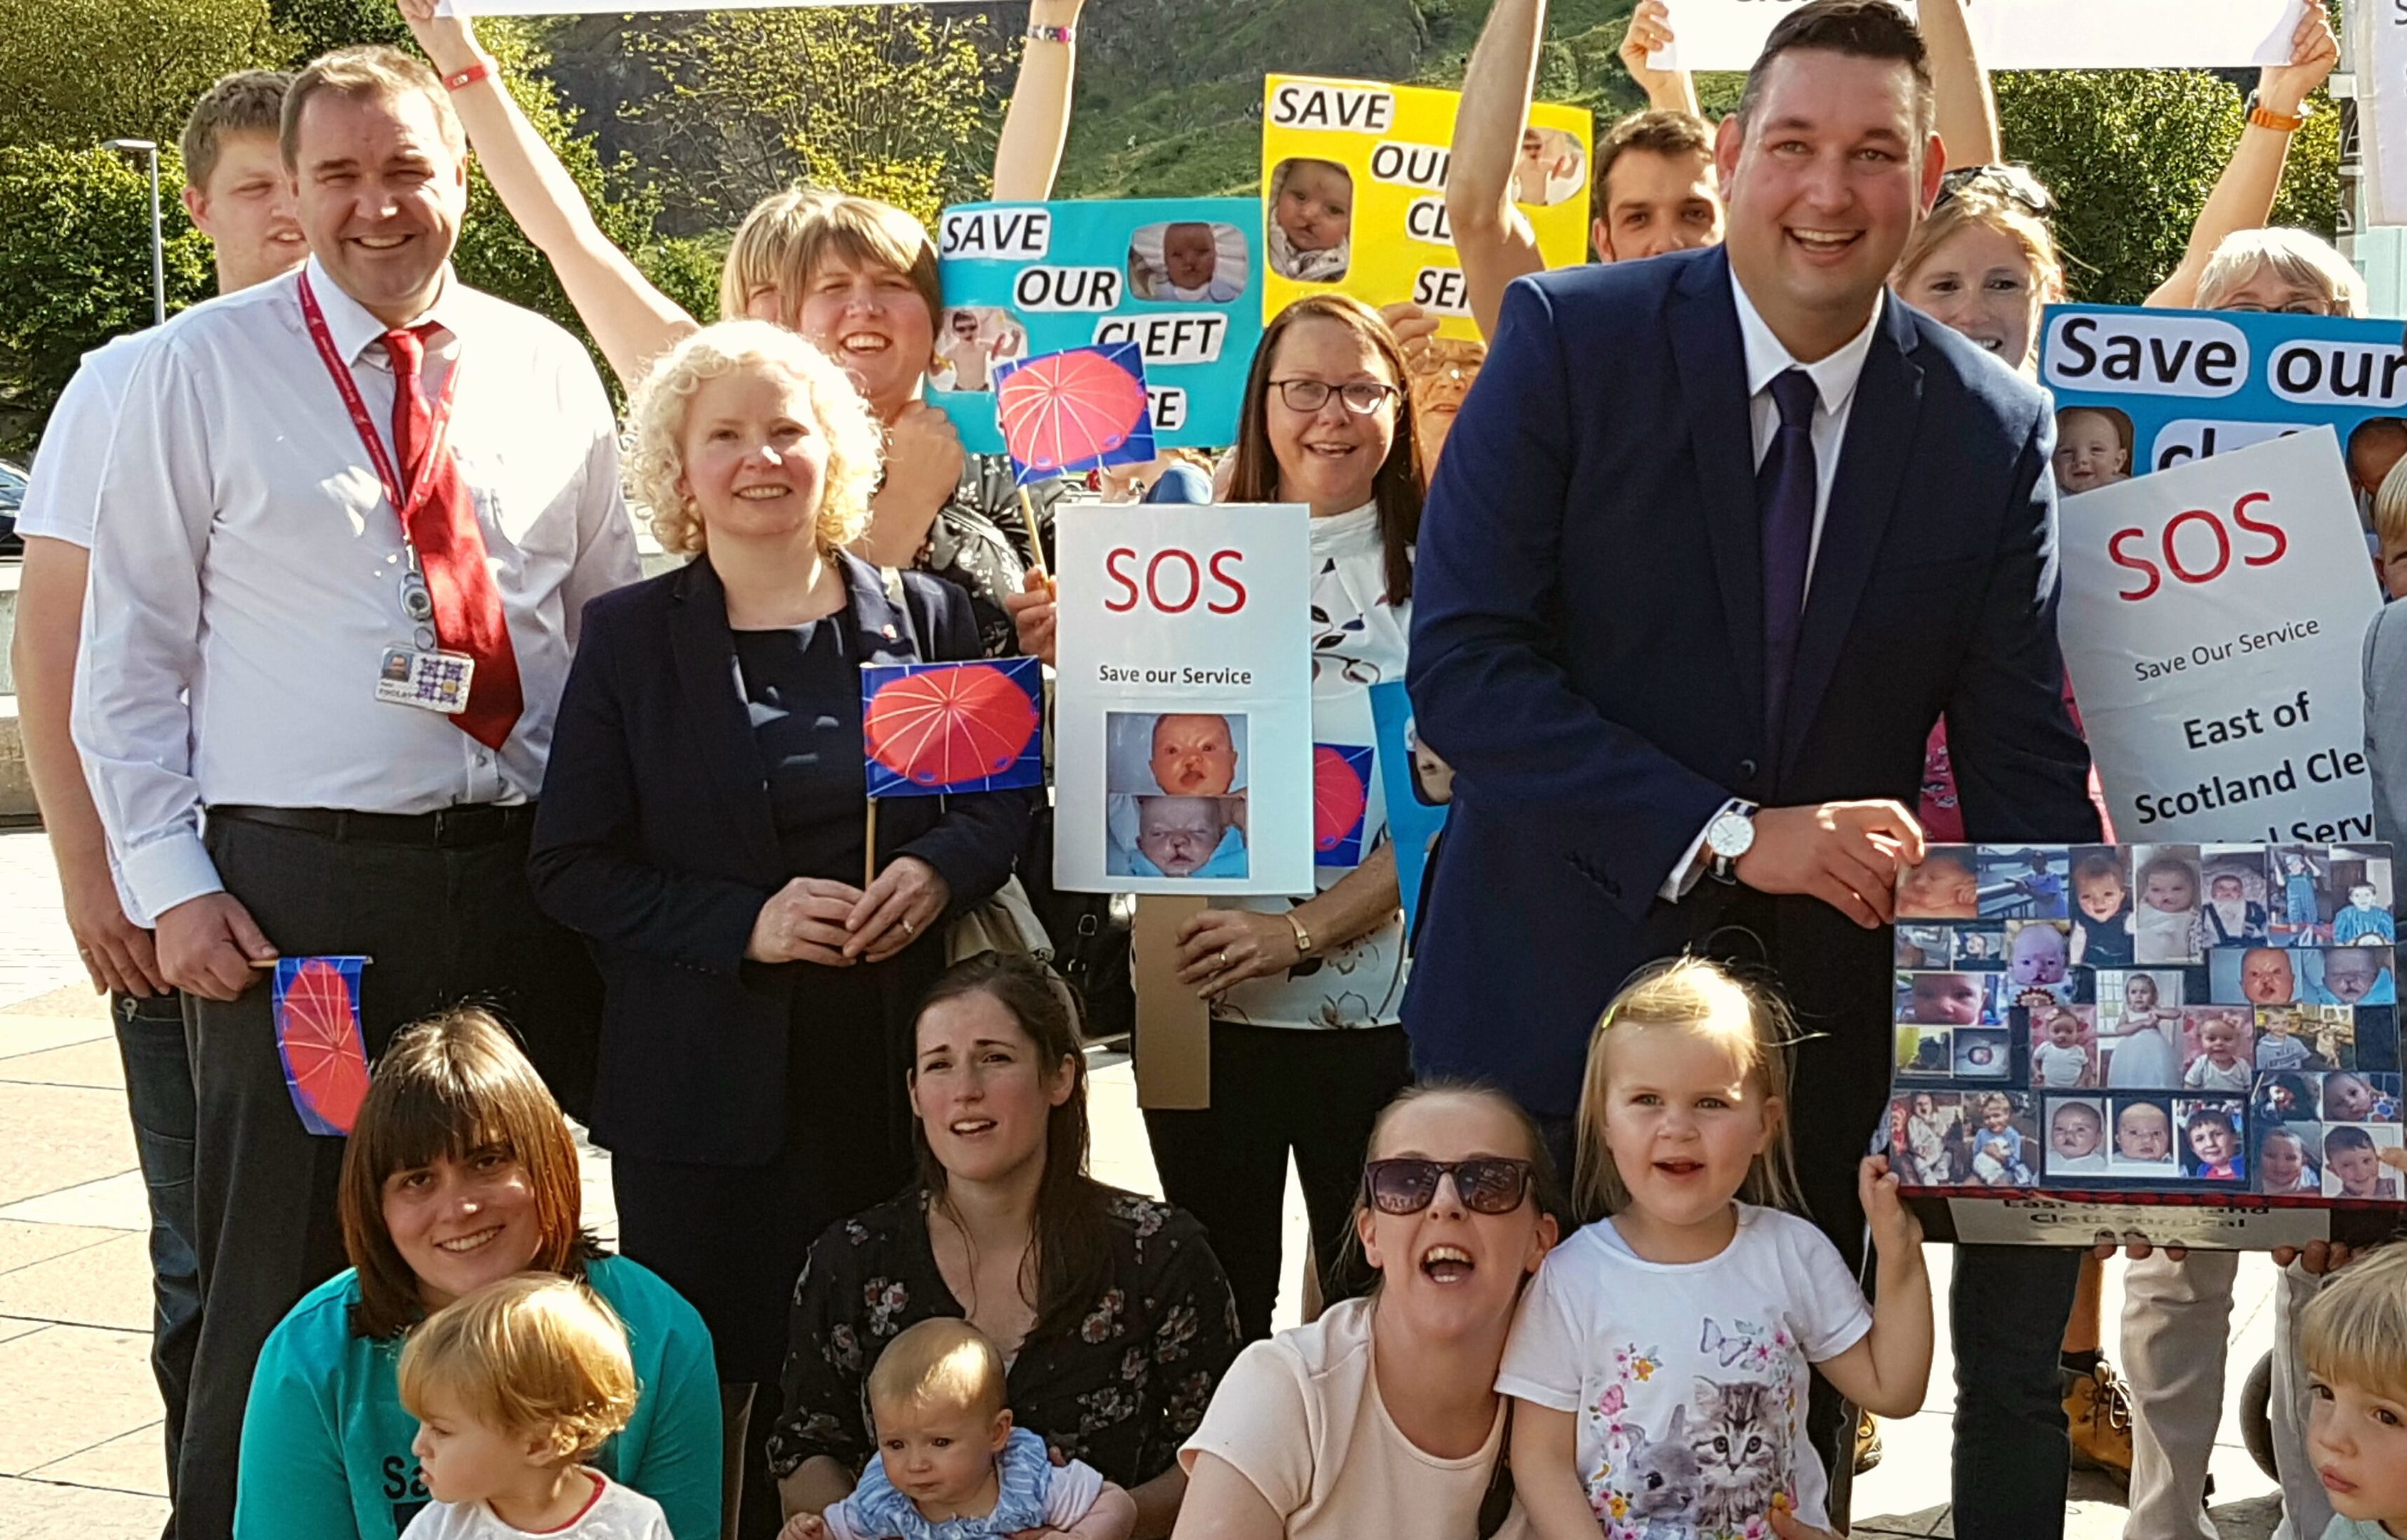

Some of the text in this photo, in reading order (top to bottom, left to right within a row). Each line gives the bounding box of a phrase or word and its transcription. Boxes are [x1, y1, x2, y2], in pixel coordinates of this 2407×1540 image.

[1275, 88, 1390, 128] SAVE
[943, 214, 1047, 254] SAVE
[1017, 269, 1117, 307] OUR
[2056, 318, 2407, 399] Save our
[2108, 491, 2288, 602] SOS
[1104, 547, 1248, 615] SOS
[1099, 664, 1252, 685] Save our Service
[2135, 620, 2320, 682] Save Our Service
[2183, 690, 2310, 750] East of
[2135, 759, 2296, 825] Scotland
